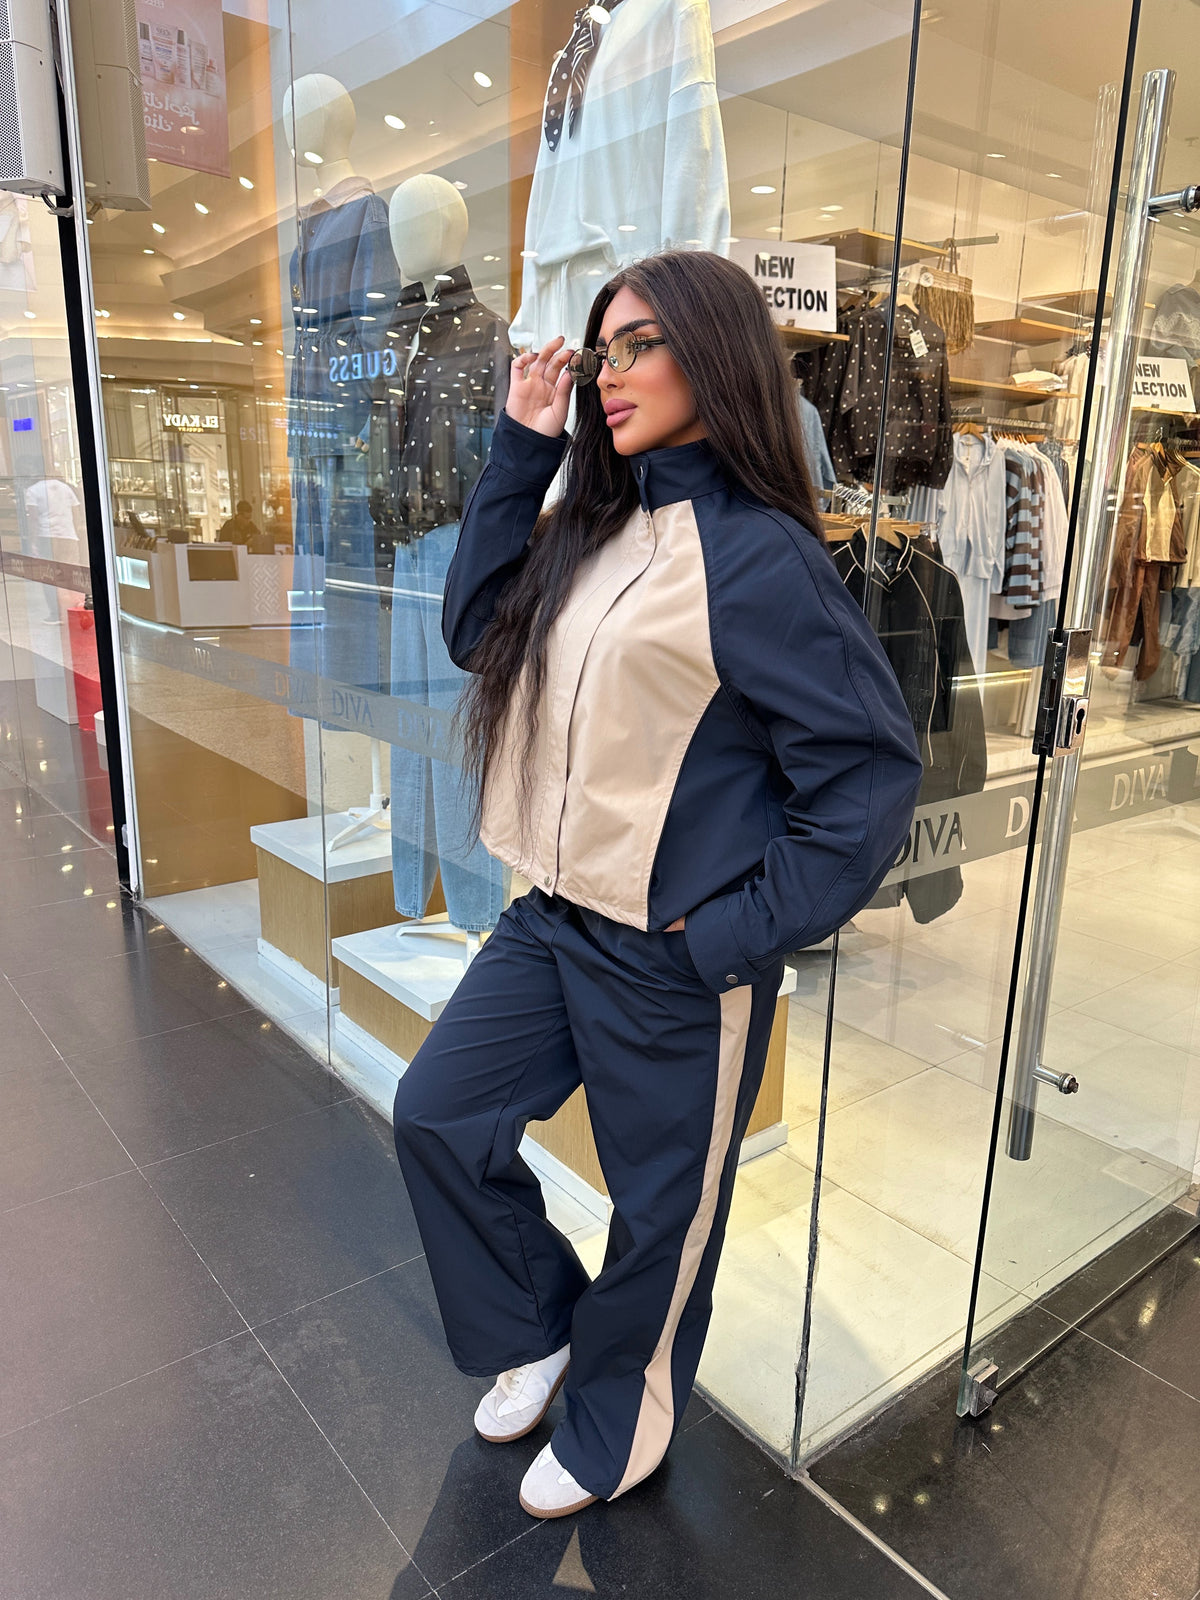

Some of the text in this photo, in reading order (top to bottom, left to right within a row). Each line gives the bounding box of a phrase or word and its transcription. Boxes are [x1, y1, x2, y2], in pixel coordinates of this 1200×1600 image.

[754, 254, 795, 279] NEW
[762, 285, 828, 312] ECTION
[1135, 363, 1161, 378] NEW
[1133, 381, 1187, 398] LECTION
[331, 688, 375, 728] DIVA
[1110, 763, 1167, 812] DIVA
